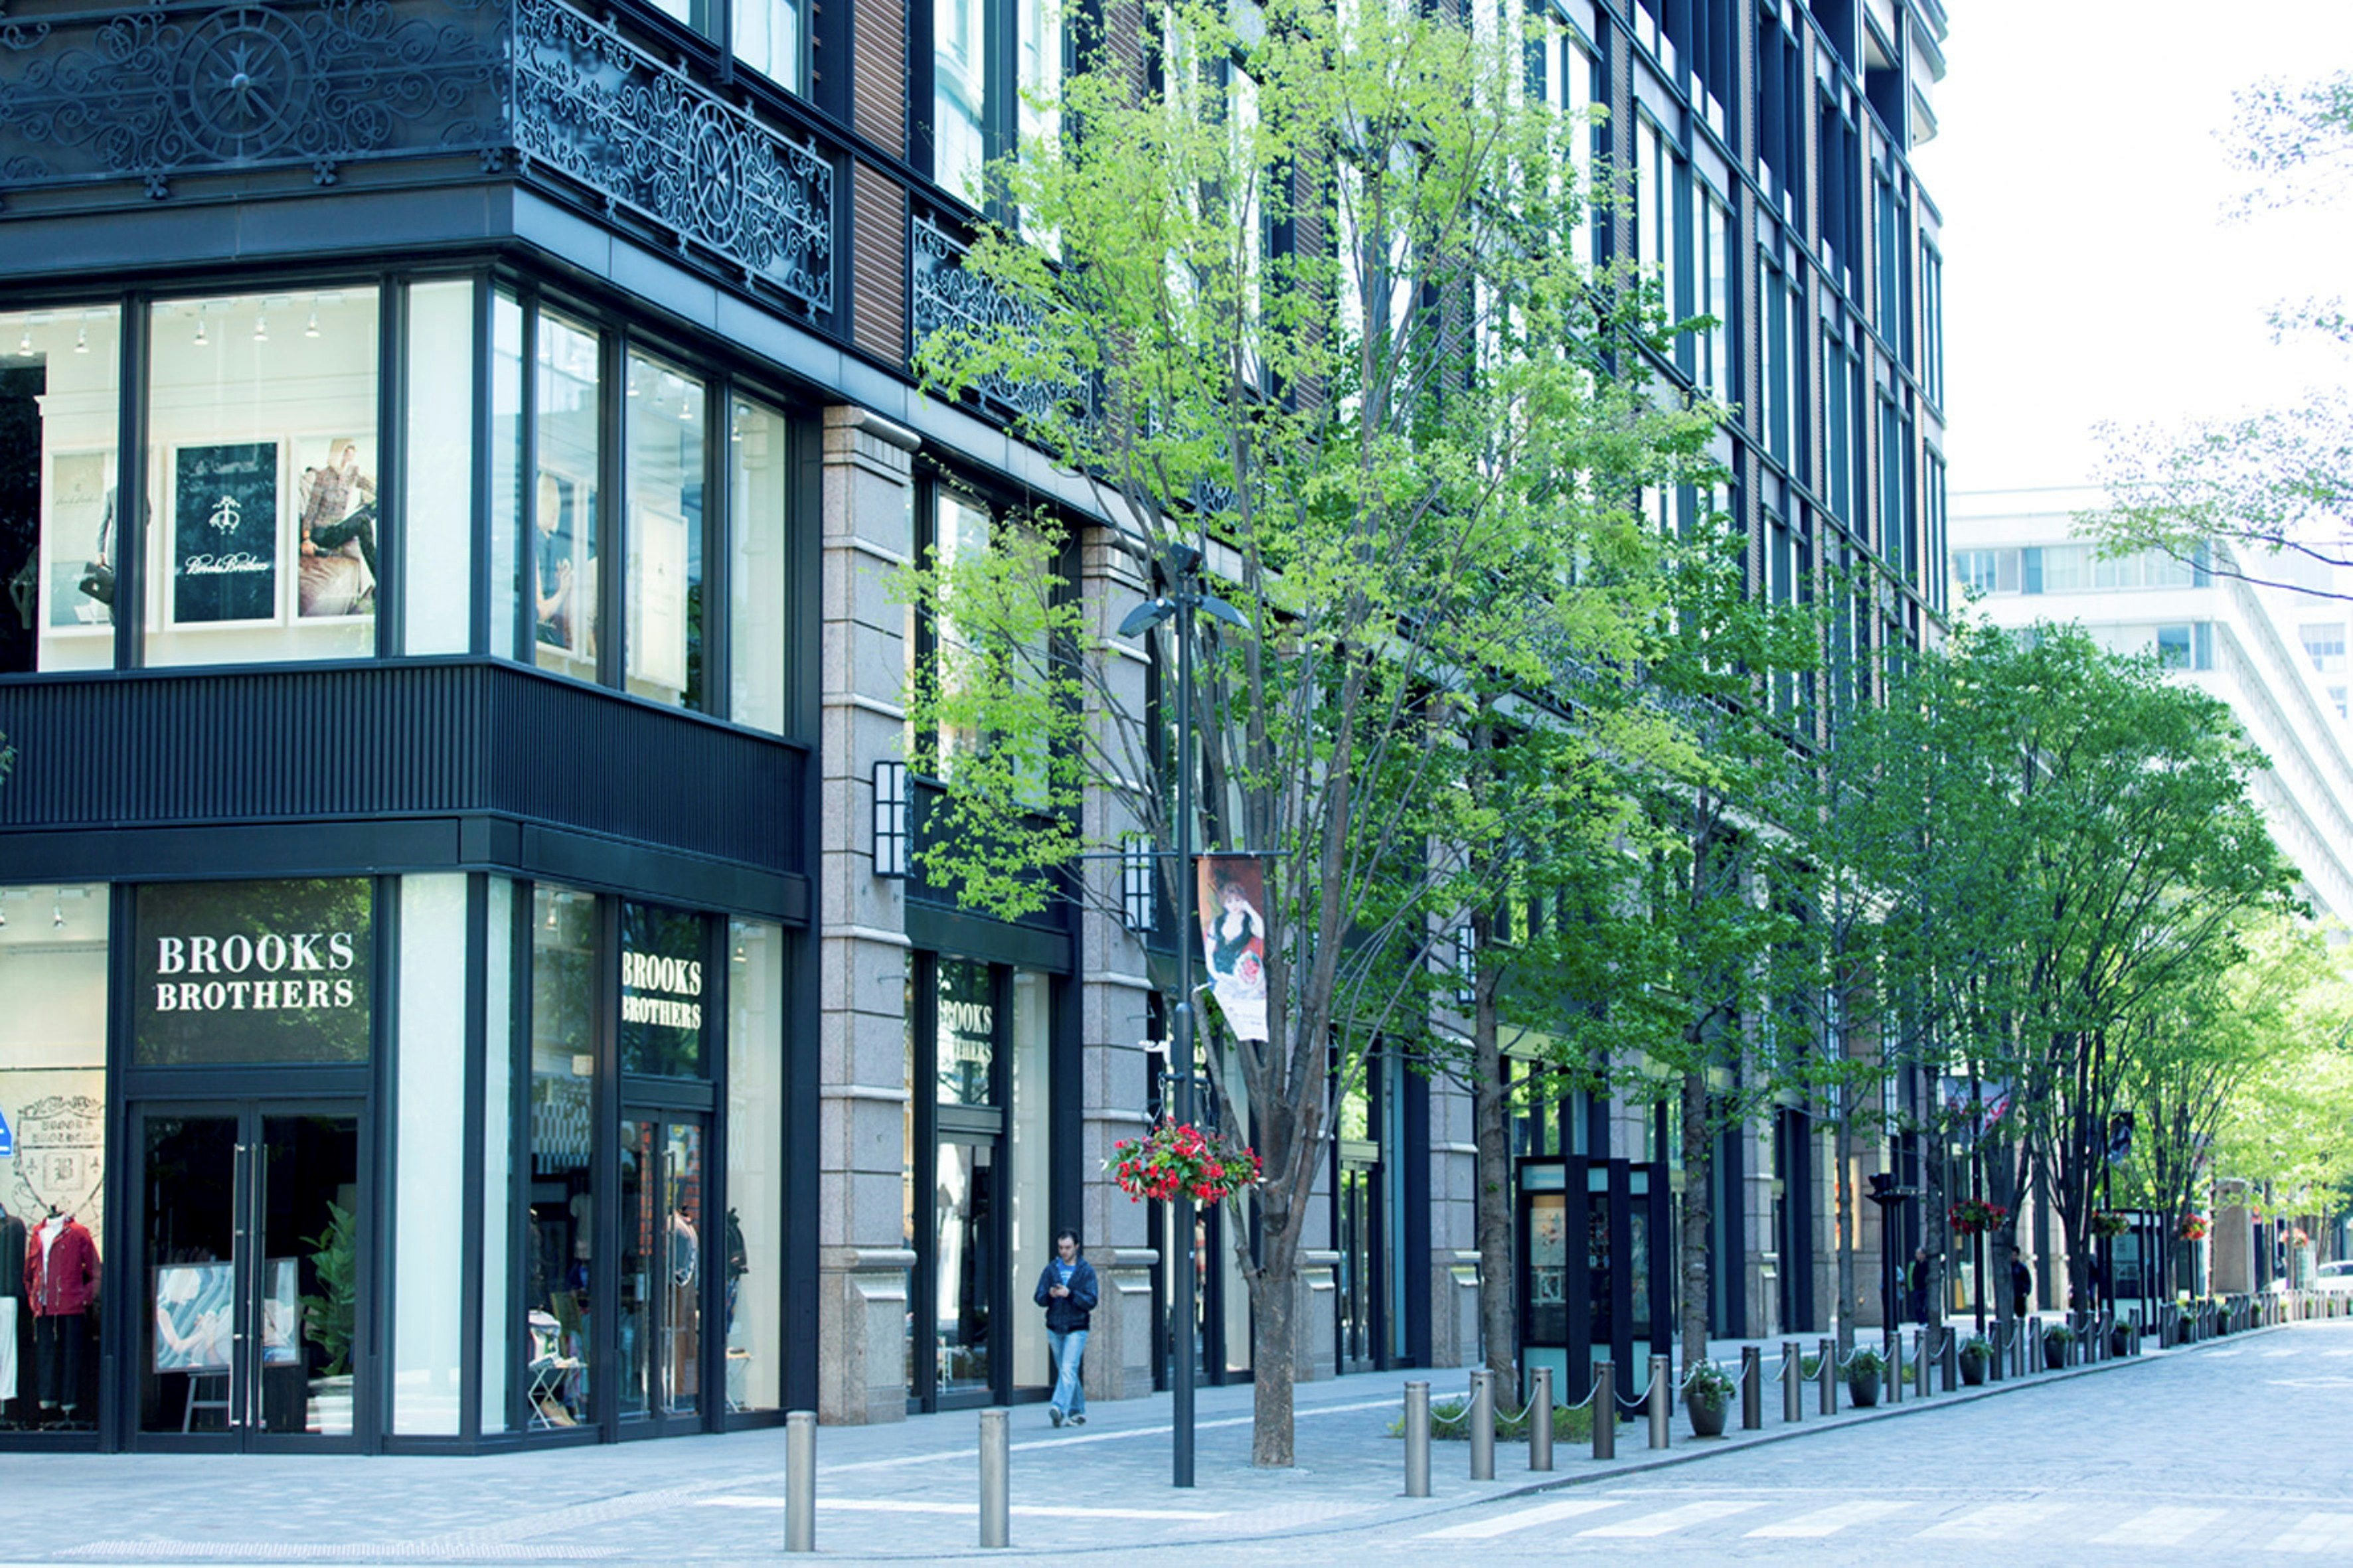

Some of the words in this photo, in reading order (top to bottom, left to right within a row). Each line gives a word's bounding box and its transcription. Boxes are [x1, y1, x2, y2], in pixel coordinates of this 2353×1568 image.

[157, 932, 354, 974] BROOKS
[622, 951, 702, 996] BROOKS
[156, 979, 354, 1011] BROTHERS
[622, 995, 702, 1030] BROTHERS
